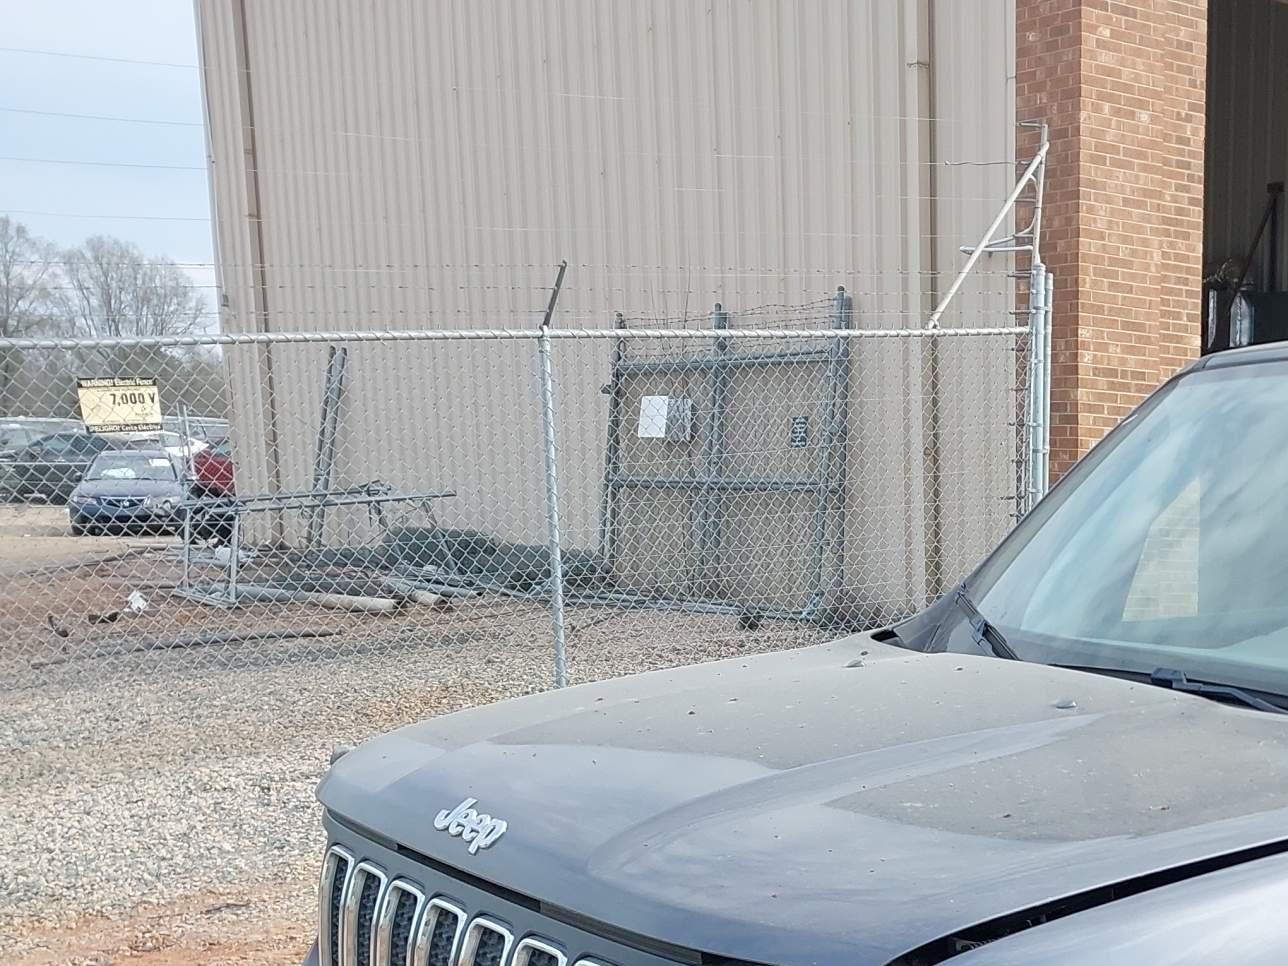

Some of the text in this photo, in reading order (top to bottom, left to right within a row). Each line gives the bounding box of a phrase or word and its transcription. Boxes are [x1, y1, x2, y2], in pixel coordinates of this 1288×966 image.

[109, 392, 155, 406] 7,000 V
[434, 798, 508, 854] Jeep
